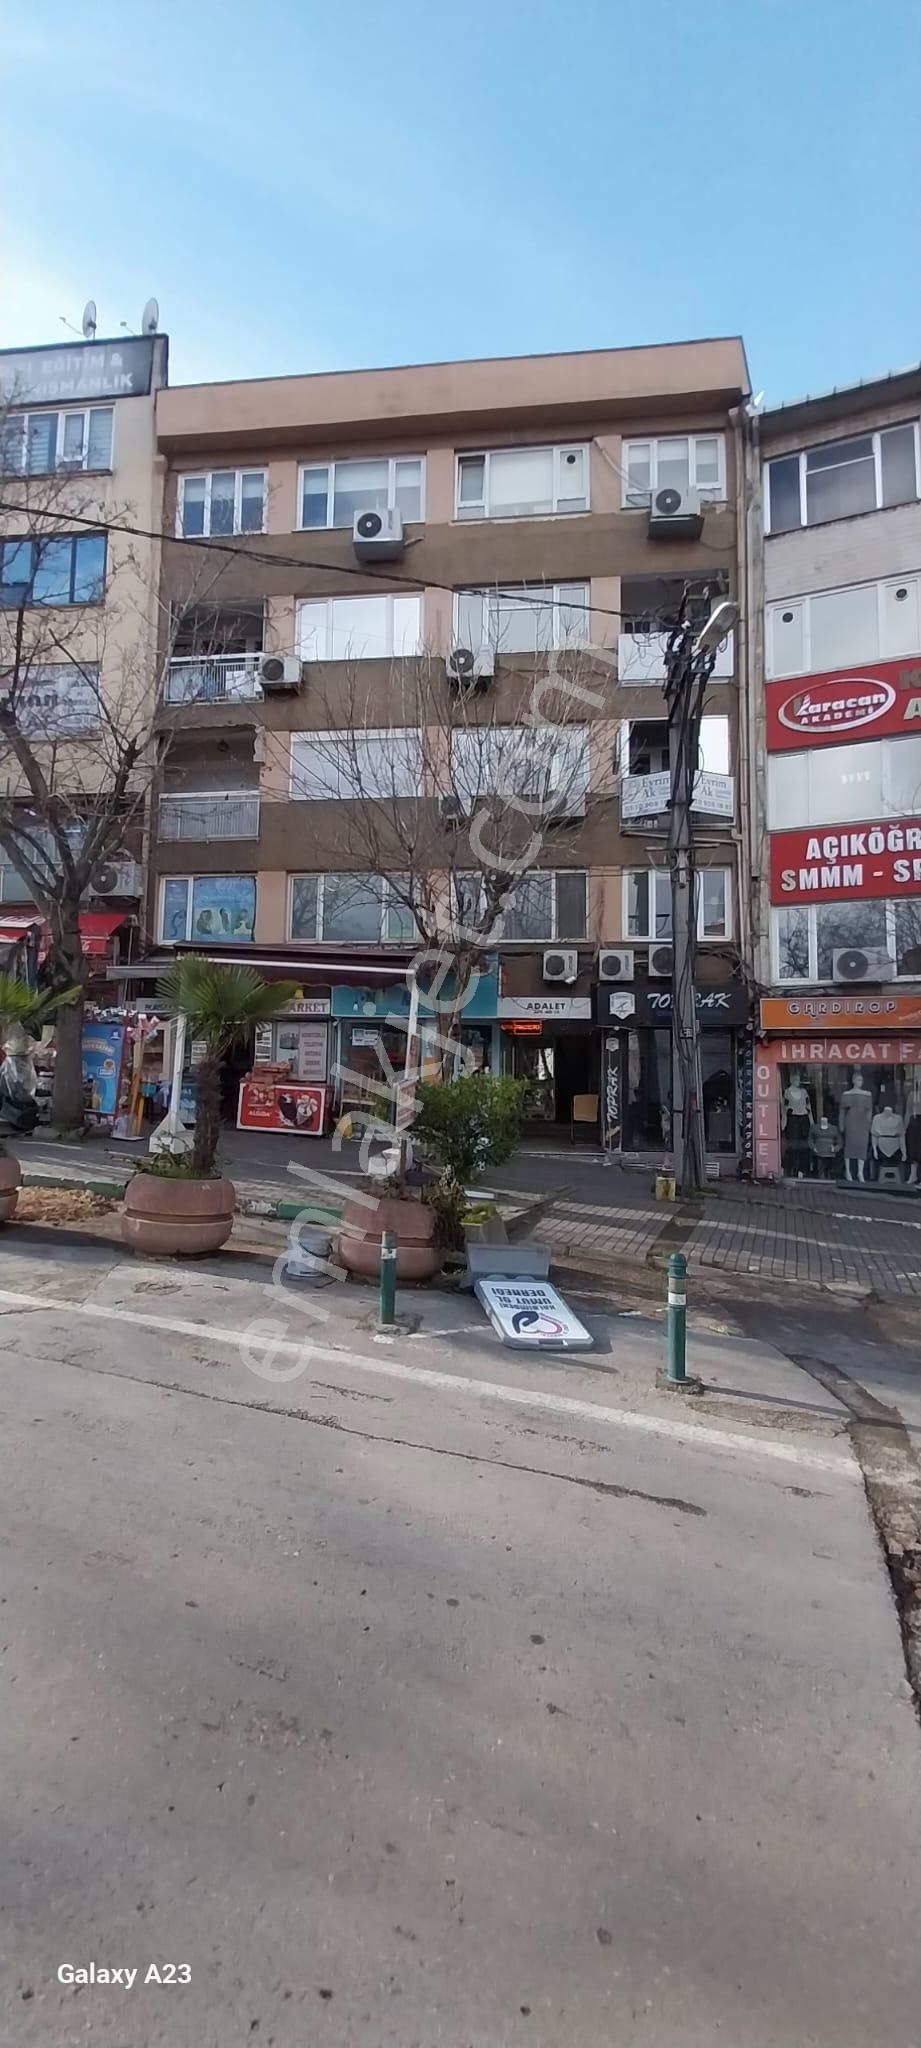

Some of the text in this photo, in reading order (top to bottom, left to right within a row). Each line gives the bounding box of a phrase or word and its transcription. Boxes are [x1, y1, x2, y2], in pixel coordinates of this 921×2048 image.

[111, 353, 123, 367] &
[781, 864, 863, 892] SMMM
[527, 1002, 566, 1010] ADALET
[781, 1040, 891, 1060] İHRACAT
[606, 1066, 619, 1123] TOPRAK
[757, 1065, 771, 1175] OUTLET
